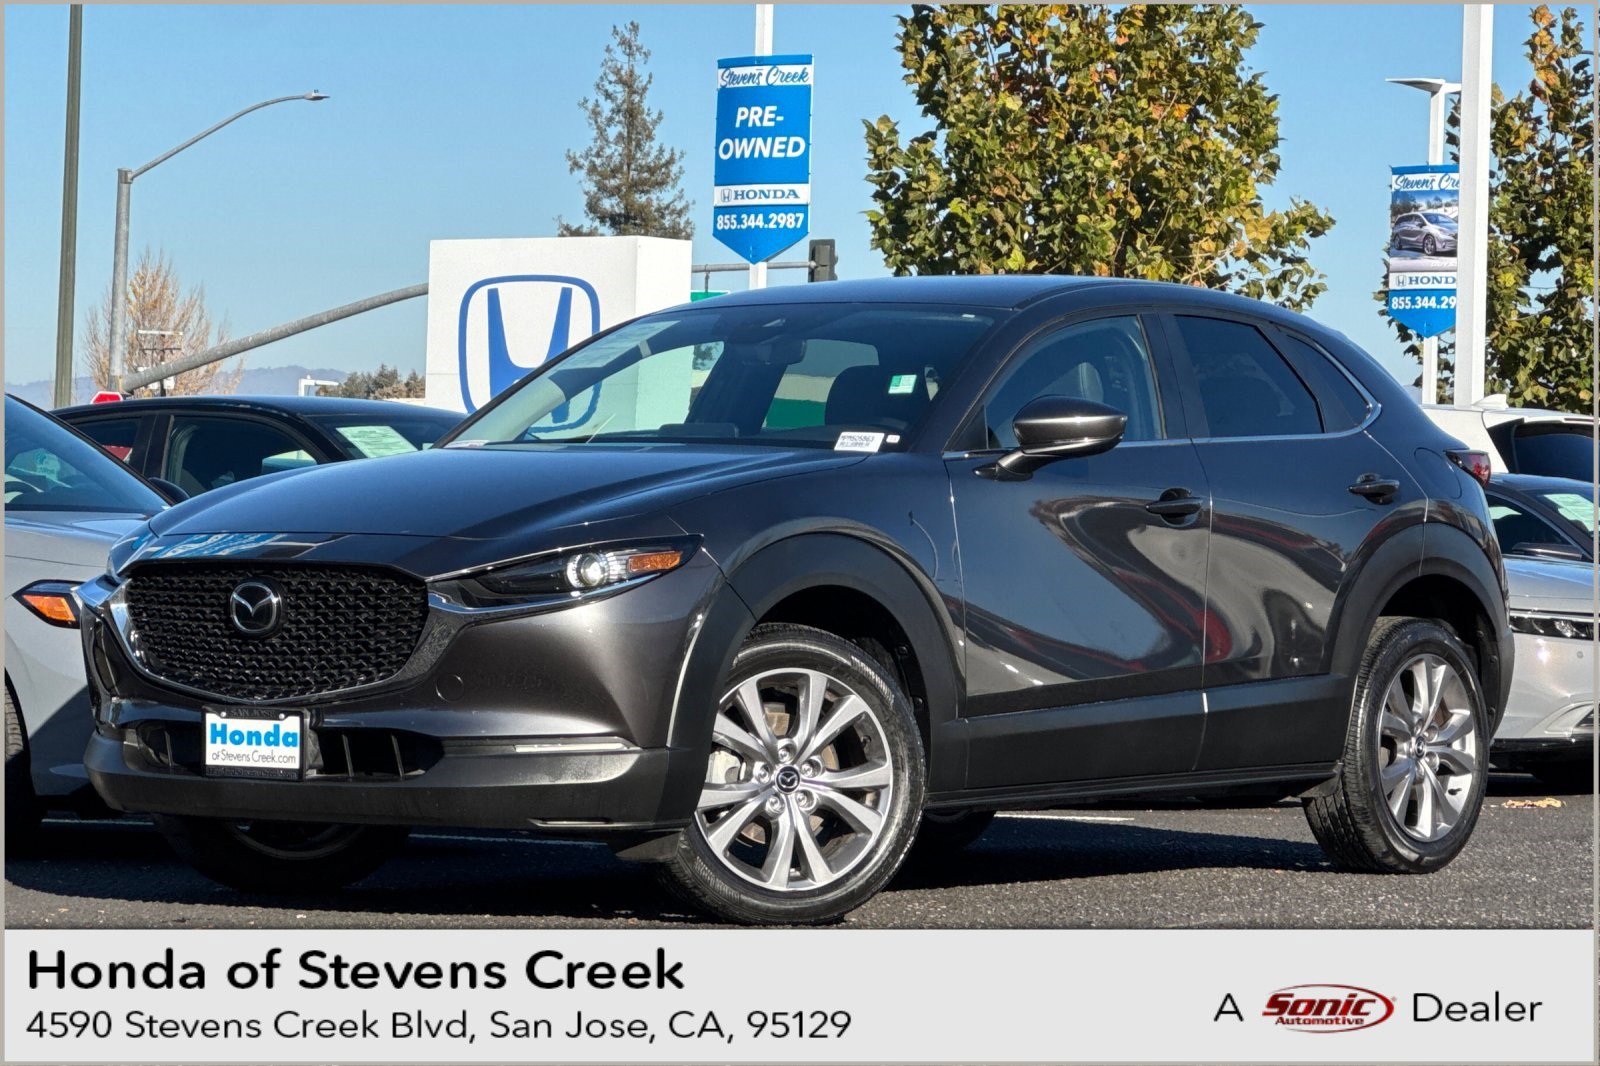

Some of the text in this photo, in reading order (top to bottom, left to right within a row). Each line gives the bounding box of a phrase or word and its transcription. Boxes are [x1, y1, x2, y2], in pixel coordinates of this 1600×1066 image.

[765, 66, 810, 86] Creek
[735, 105, 784, 128] PRE-
[718, 136, 806, 160] OWNED
[1438, 173, 1459, 190] Cre
[734, 188, 800, 201] HONDA
[717, 212, 805, 230] 855.344.2987
[1408, 276, 1456, 285] HOND
[1391, 296, 1456, 310] 855.344.29
[210, 722, 298, 748] Honda
